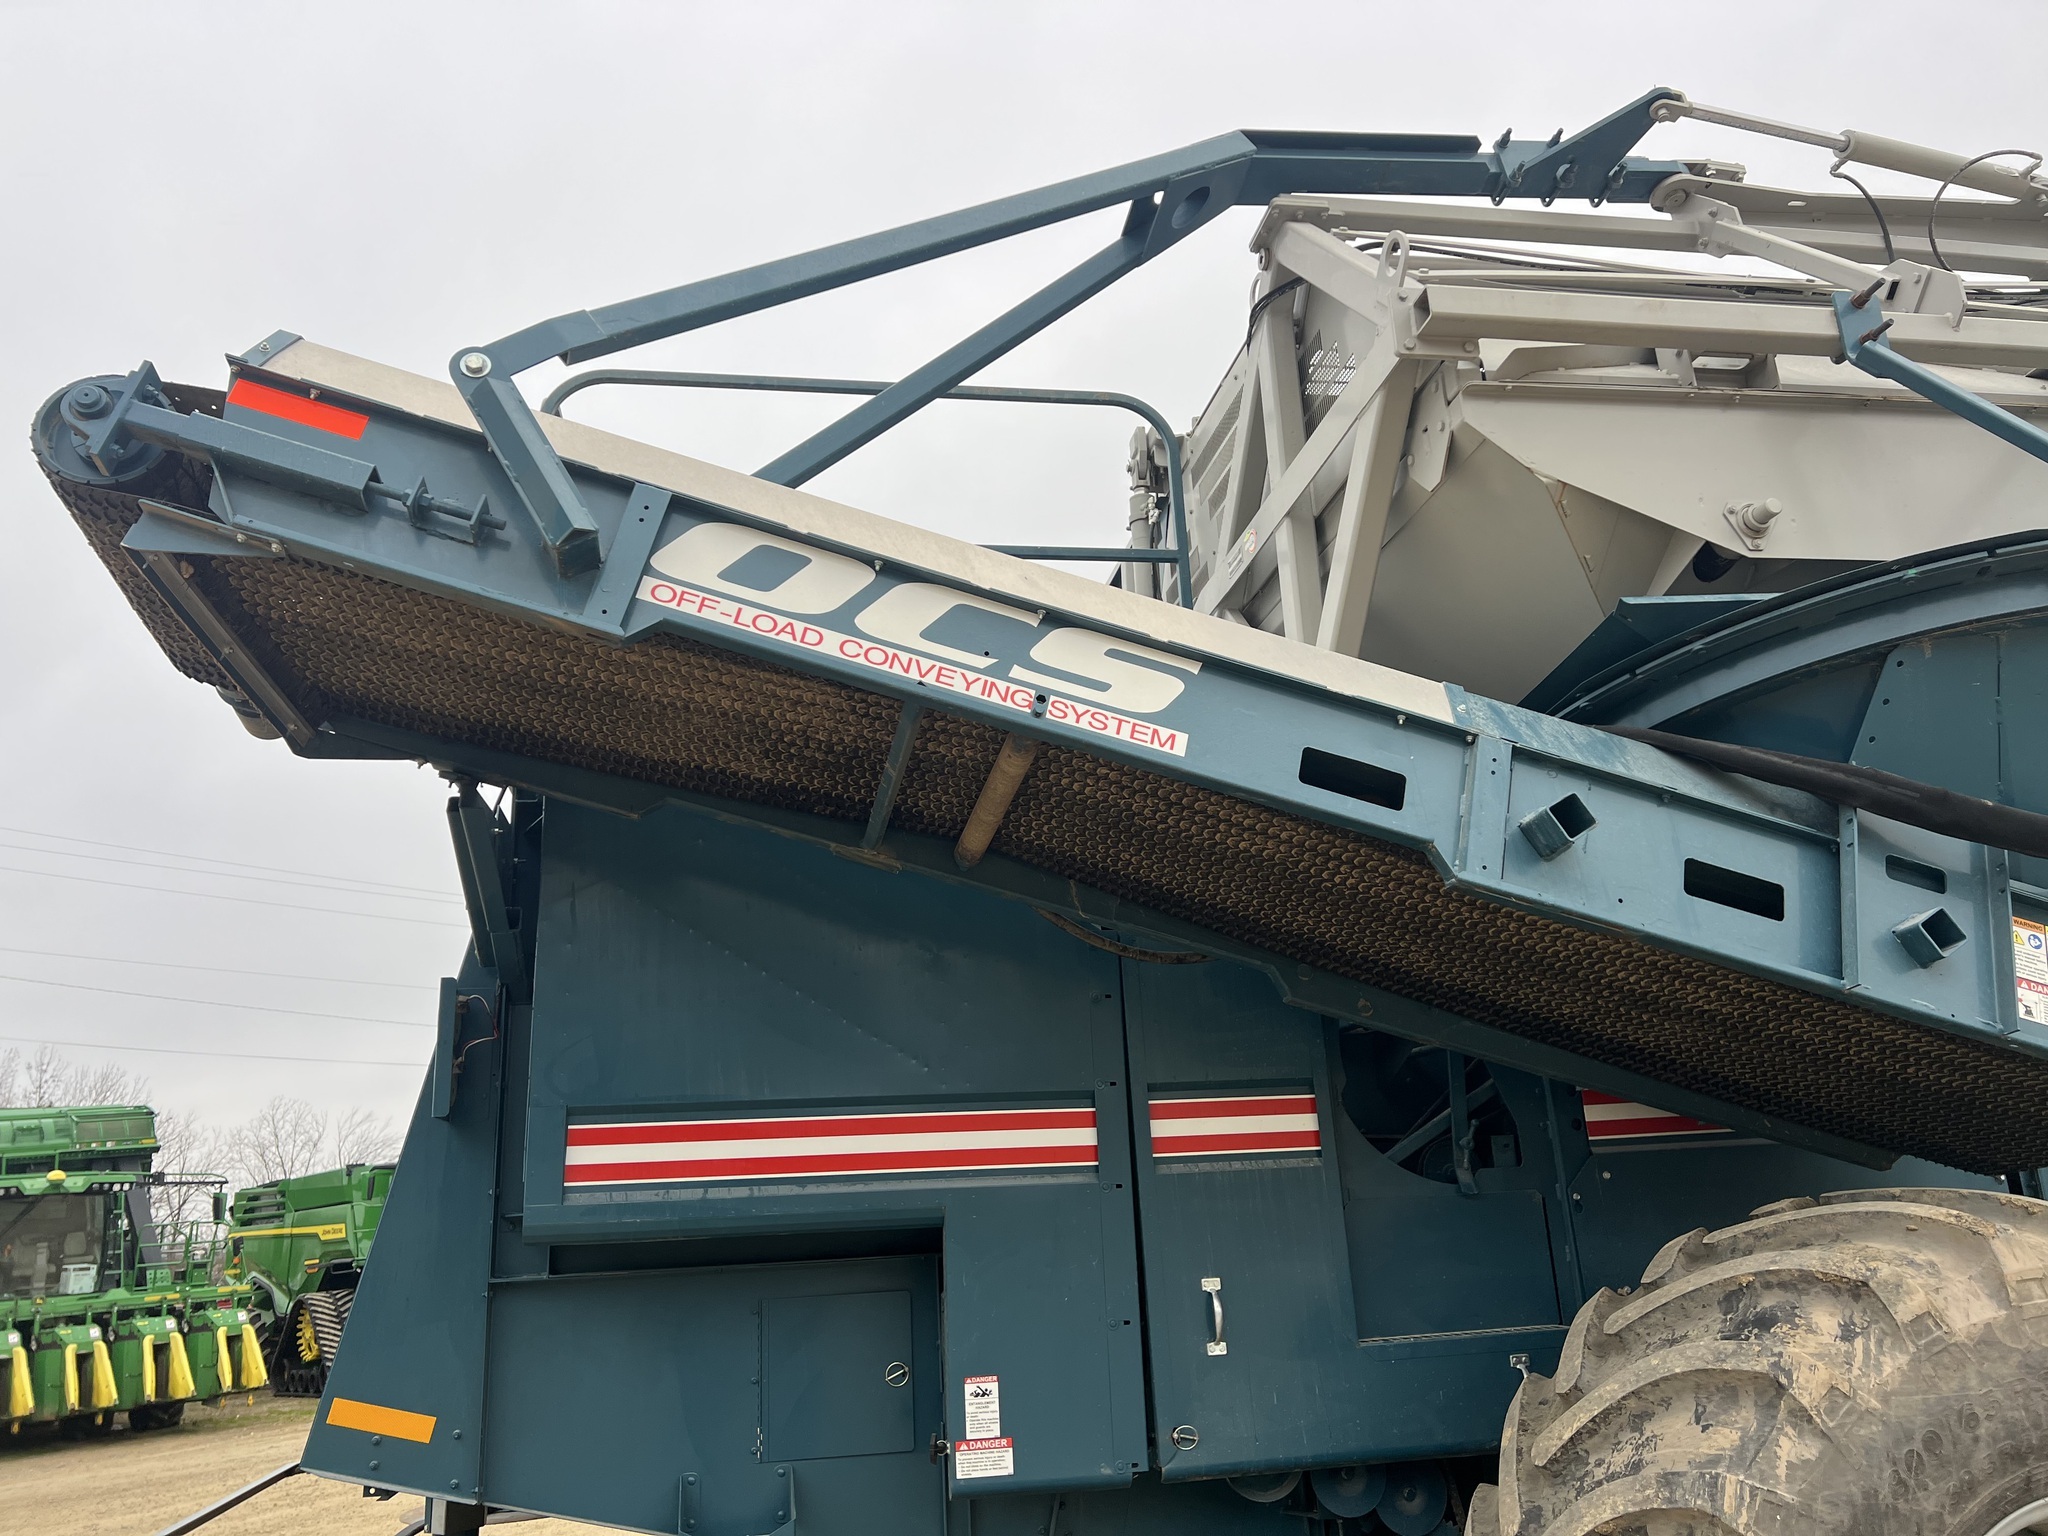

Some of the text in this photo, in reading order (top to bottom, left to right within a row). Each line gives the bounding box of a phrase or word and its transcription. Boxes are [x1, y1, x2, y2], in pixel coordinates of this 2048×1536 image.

[650, 522, 1203, 714] OCS
[650, 583, 1176, 751] OFF-LOAD CONVEYING SYSTEM
[2013, 918, 2044, 932] WARNING
[971, 1375, 998, 1383] DANGER
[969, 1438, 1008, 1450] DANGER
